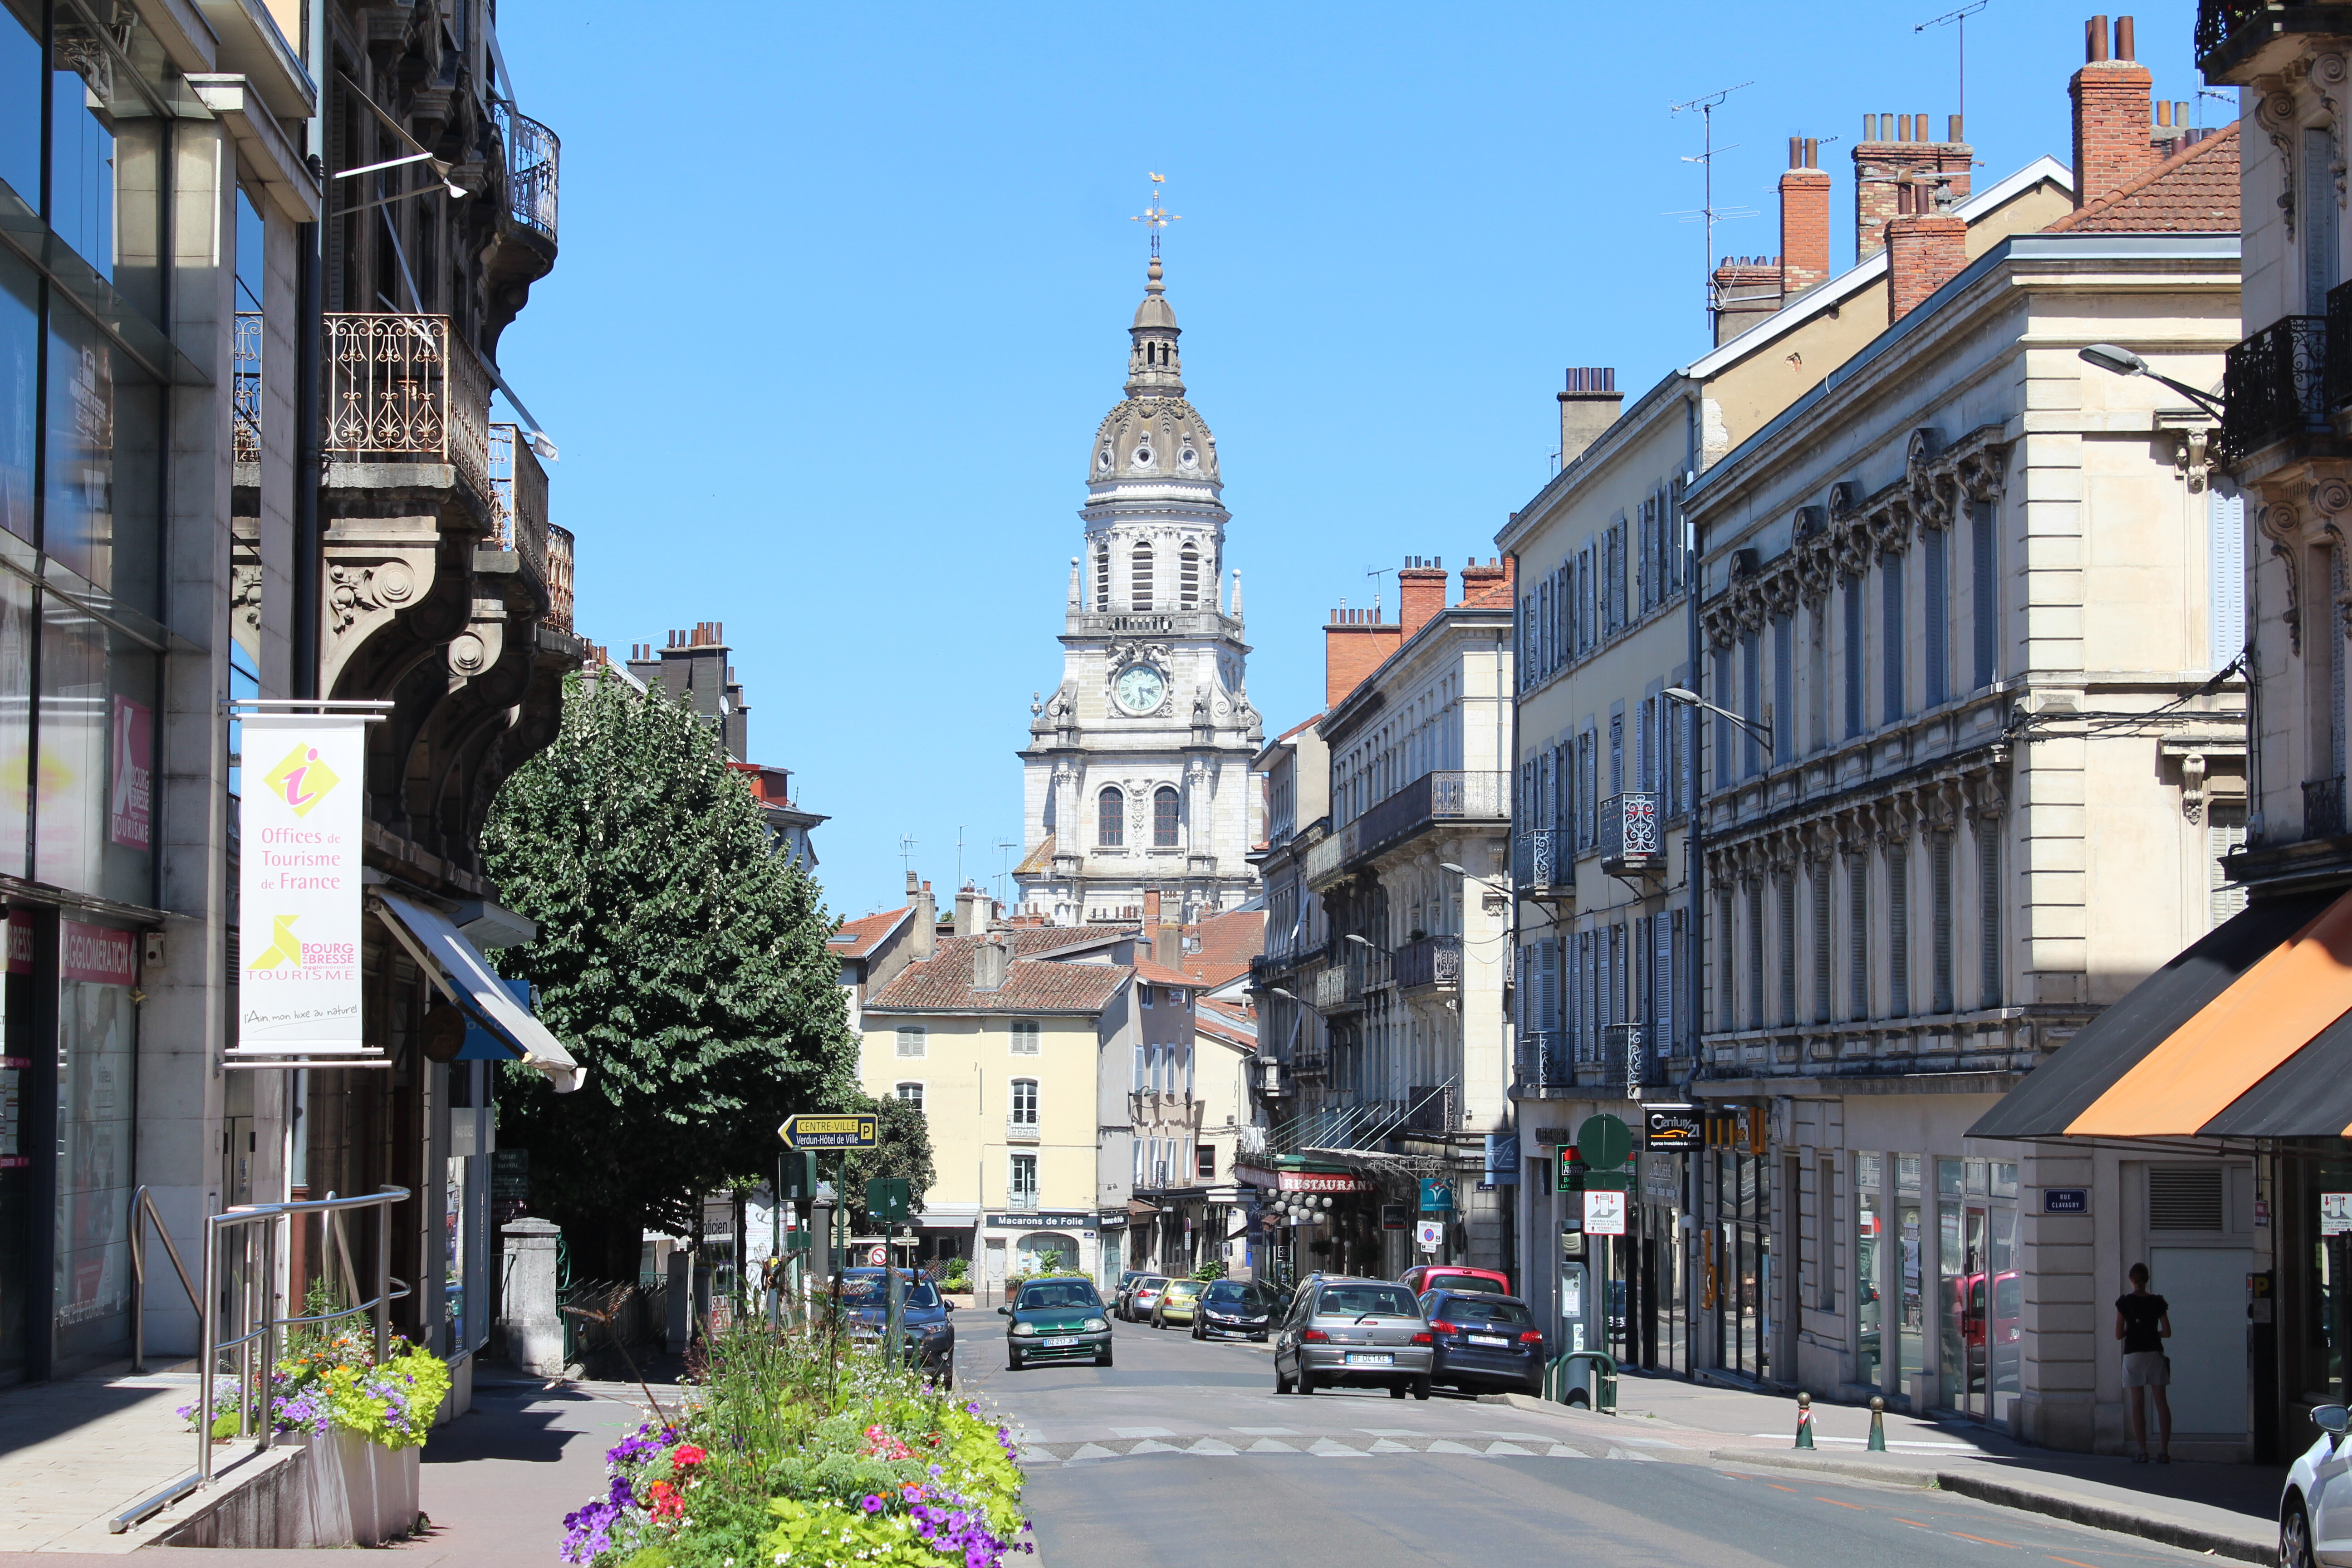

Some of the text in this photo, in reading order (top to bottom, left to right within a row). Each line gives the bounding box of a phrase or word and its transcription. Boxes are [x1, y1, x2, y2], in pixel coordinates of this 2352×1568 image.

[132, 766, 149, 791] BOURG
[112, 814, 148, 843] TOURISME
[261, 828, 341, 843] Offices de
[261, 850, 340, 866] Tourisme
[261, 872, 340, 889] de France
[63, 929, 128, 974] AGGLOMÉRATION
[302, 943, 354, 954] BOURG
[302, 954, 354, 964] EN BRESSE
[245, 970, 354, 980] TOURISME
[245, 1010, 271, 1024] l'Ain,
[294, 1010, 310, 1019] luxe
[327, 1004, 357, 1016] naturel
[799, 1122, 856, 1132] CENTRE-VILLE
[1651, 1114, 1692, 1130] Century
[863, 1125, 870, 1137] P
[1687, 1124, 1700, 1138] 21
[796, 1134, 858, 1145] Verdun-Hôtel de Ville
[1284, 1178, 1374, 1191] RESTAURANT
[999, 1216, 1084, 1225] Macarons de Folie
[1908, 1228, 1918, 1241] LOUER
[771, 1258, 778, 1268] P
[2254, 1277, 2269, 1298] P
[1352, 1354, 1387, 1362] BF-041-KE
